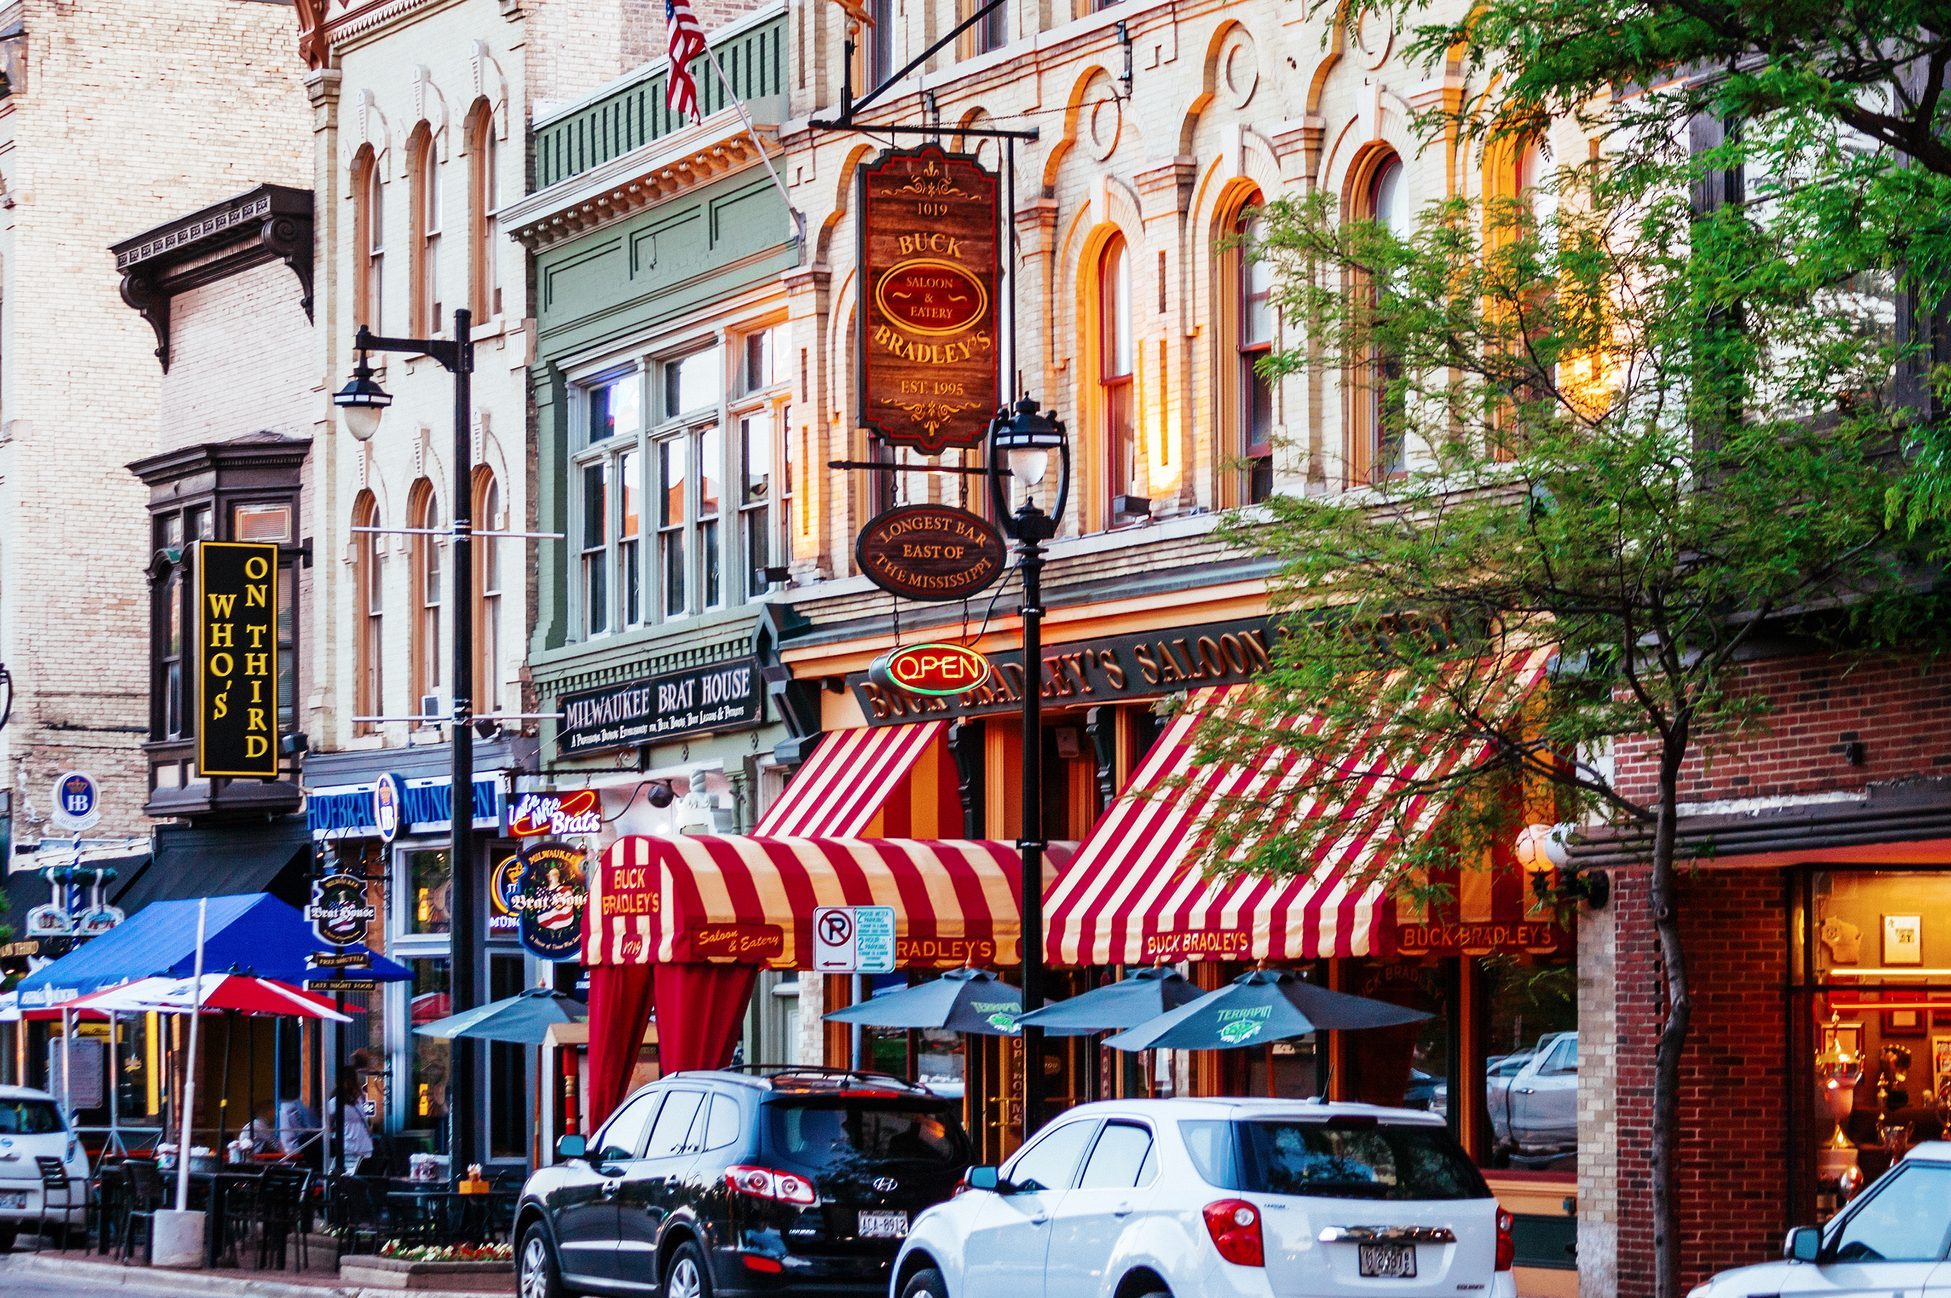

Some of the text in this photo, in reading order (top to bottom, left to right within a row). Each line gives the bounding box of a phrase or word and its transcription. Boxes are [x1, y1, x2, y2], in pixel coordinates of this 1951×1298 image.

[918, 203, 948, 216] 1019
[898, 232, 964, 258] BUCK
[906, 277, 953, 288] SALOON
[924, 292, 934, 303] &
[910, 306, 953, 319] EATERY
[874, 323, 991, 364] BRADLEY'S
[901, 381, 964, 396] EST. 1995
[880, 517, 987, 548] LONGEST BAR
[903, 544, 965, 559] EAST OF
[875, 552, 993, 589] THE MISSISSIPPI
[207, 593, 237, 721] WHO'S
[245, 556, 268, 758] ON THIRD
[1133, 629, 1273, 686] SALOON
[897, 655, 979, 681] OPEN
[566, 688, 650, 731] MILWAUKEE
[658, 679, 698, 714] BRAT
[701, 667, 751, 706] HOUSE
[67, 794, 89, 812] HB
[551, 810, 601, 836] Brats
[613, 868, 646, 890] BUCK
[511, 894, 549, 911] Brat
[603, 891, 660, 916] BRADLEY'S
[699, 930, 739, 946] Saloon
[728, 934, 780, 953] & Eatery
[1147, 932, 1249, 955] BUCK BRADLEY'S
[1404, 926, 1453, 947] BUCK
[896, 940, 992, 958] RADLEY'S
[1216, 1004, 1273, 1023] TERRAPIN
